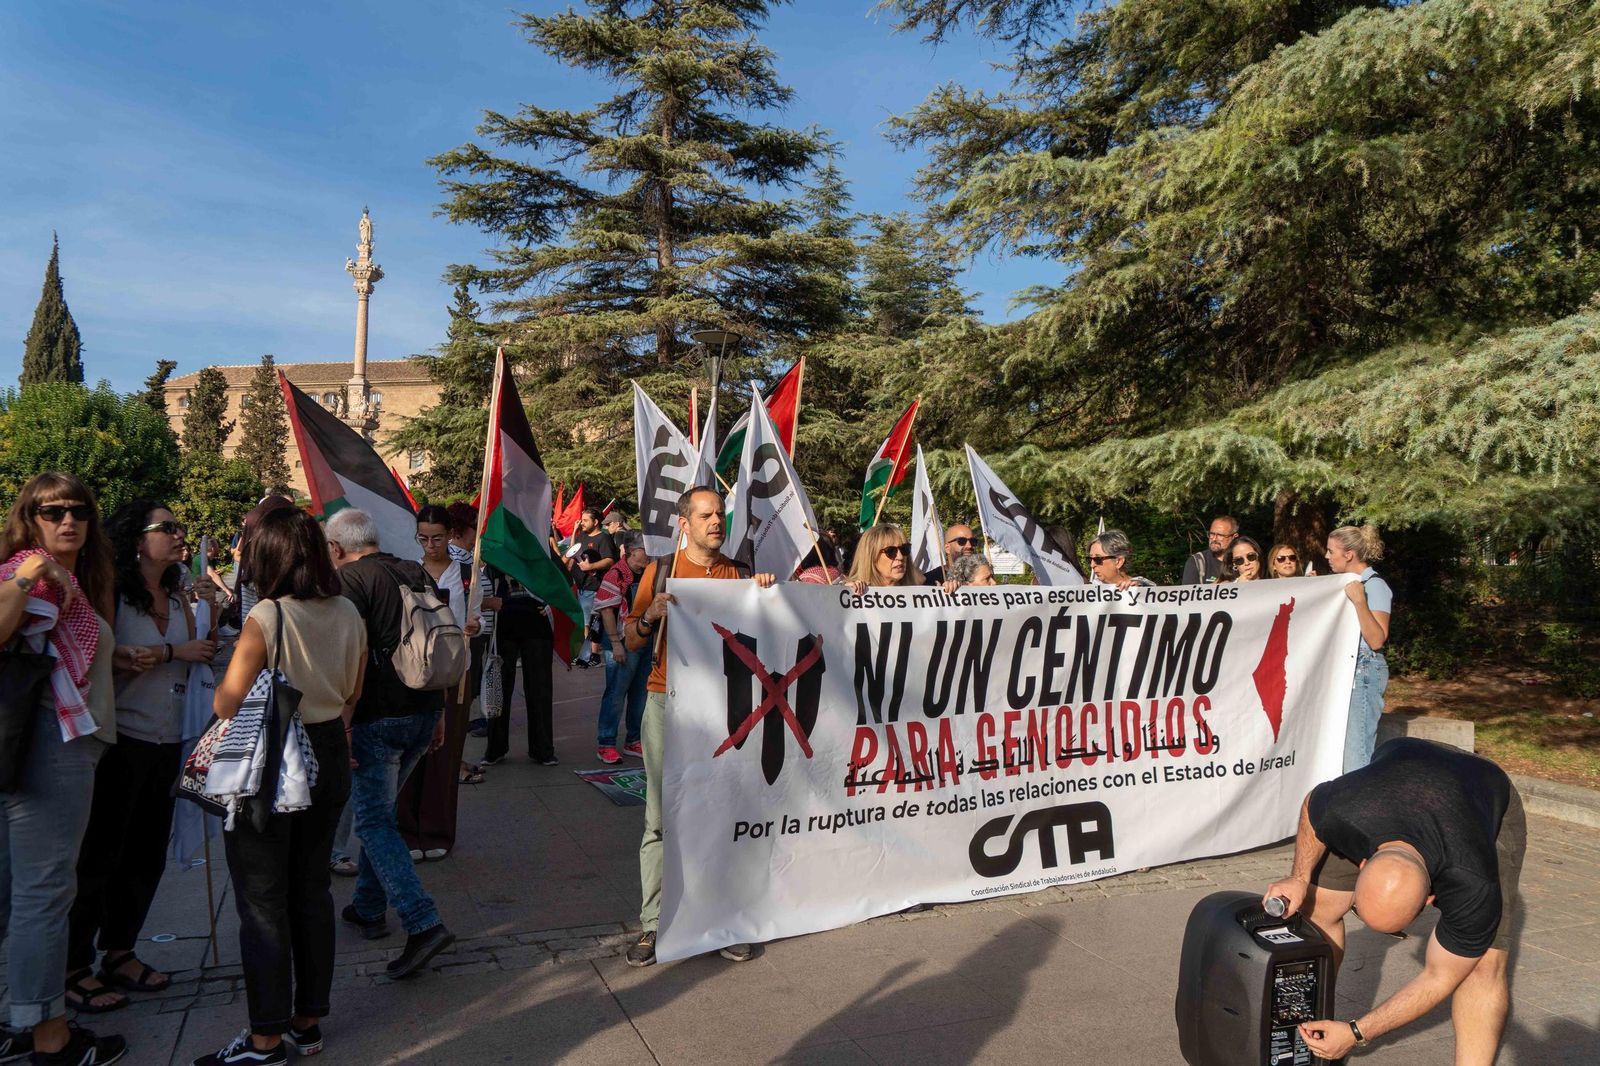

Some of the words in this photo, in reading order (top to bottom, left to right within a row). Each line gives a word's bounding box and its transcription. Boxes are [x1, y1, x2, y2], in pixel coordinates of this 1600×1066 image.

[839, 589, 907, 609] Gastos
[912, 588, 1000, 609] militares
[1003, 590, 1044, 610] para
[1047, 585, 1122, 604] escuelas
[1128, 591, 1140, 606] y
[1144, 584, 1239, 606] hospitales
[854, 621, 913, 726] NI
[922, 618, 1003, 720] UN
[1006, 605, 1233, 710] CÉNTIMO
[846, 717, 961, 797] PARA
[976, 694, 1214, 781] GENOCIDIOS
[733, 820, 774, 842] Por
[780, 814, 800, 835] la
[807, 805, 886, 834] ruptura
[892, 800, 920, 819] de
[926, 793, 978, 816] todas
[981, 788, 1005, 808] las
[1008, 775, 1098, 801] relaciones
[1103, 770, 1136, 789] con
[1141, 766, 1158, 785] el
[1163, 760, 1227, 783] Estado
[1232, 758, 1255, 776] de
[1259, 750, 1296, 773] Israel
[970, 883, 1010, 896] Coordinación
[1010, 880, 1032, 890] Sindical
[1032, 879, 1040, 887] de
[1083, 870, 1090, 878] de
[1091, 866, 1117, 876] Andalucía
